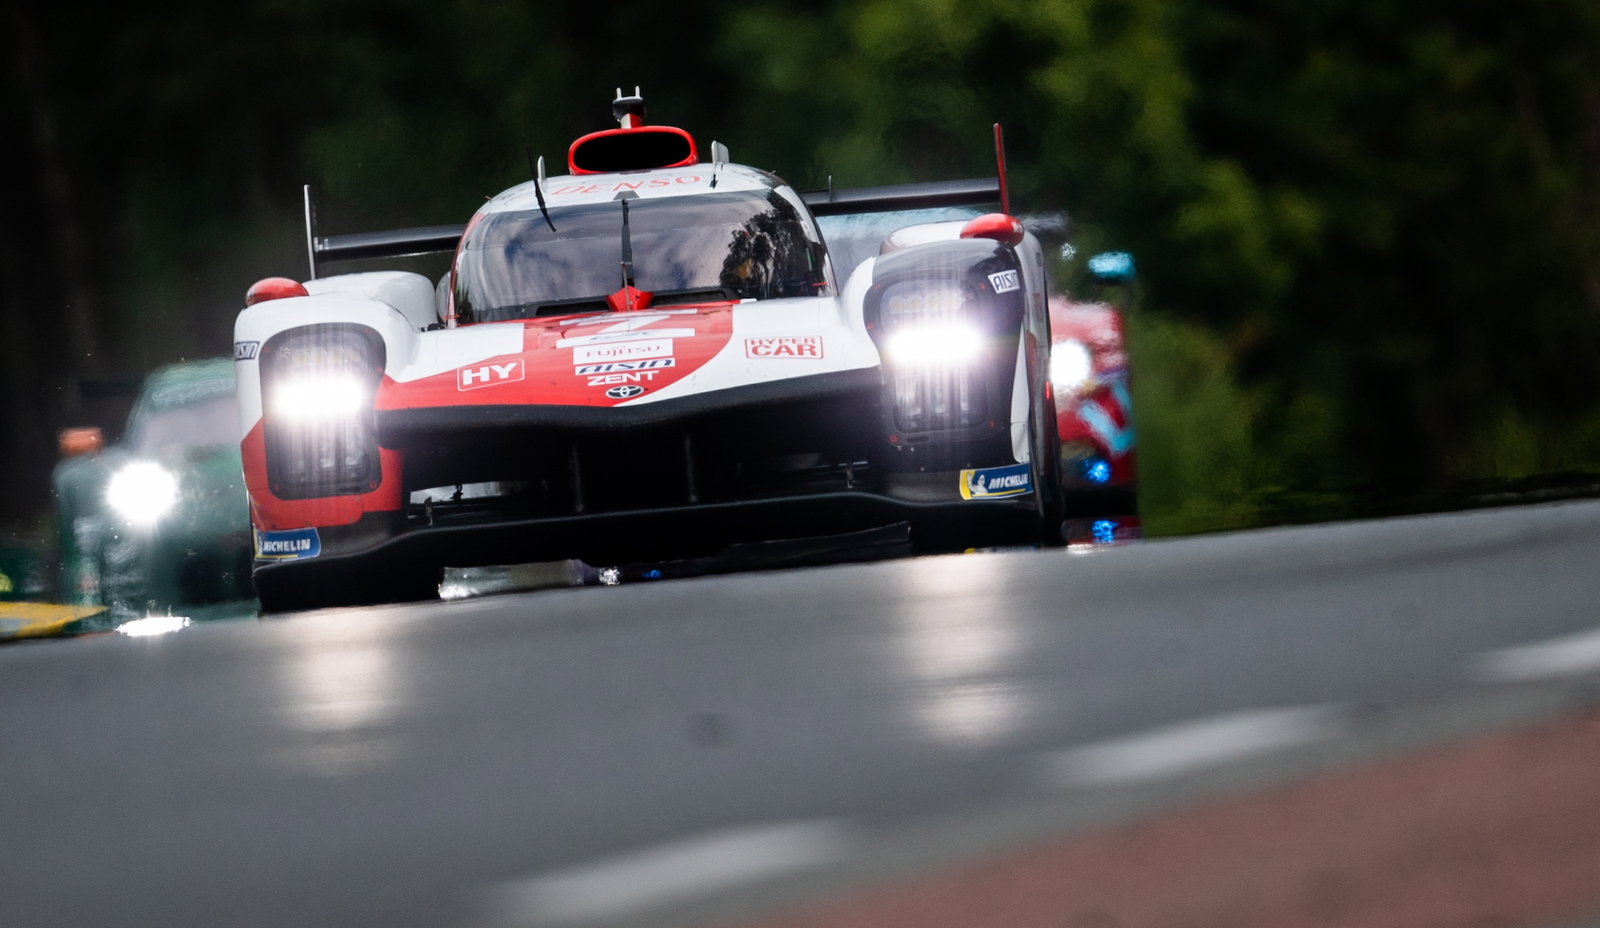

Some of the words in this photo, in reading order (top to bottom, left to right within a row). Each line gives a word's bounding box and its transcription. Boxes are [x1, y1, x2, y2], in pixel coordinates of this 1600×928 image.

[551, 175, 701, 195] DENSO
[750, 338, 816, 346] HYPER
[751, 345, 817, 357] CAR
[463, 362, 518, 386] HY
[579, 359, 673, 374] AISIN
[587, 370, 660, 387] ZENT
[988, 473, 1028, 490] MICHELIN
[263, 538, 311, 552] MICHELIN
